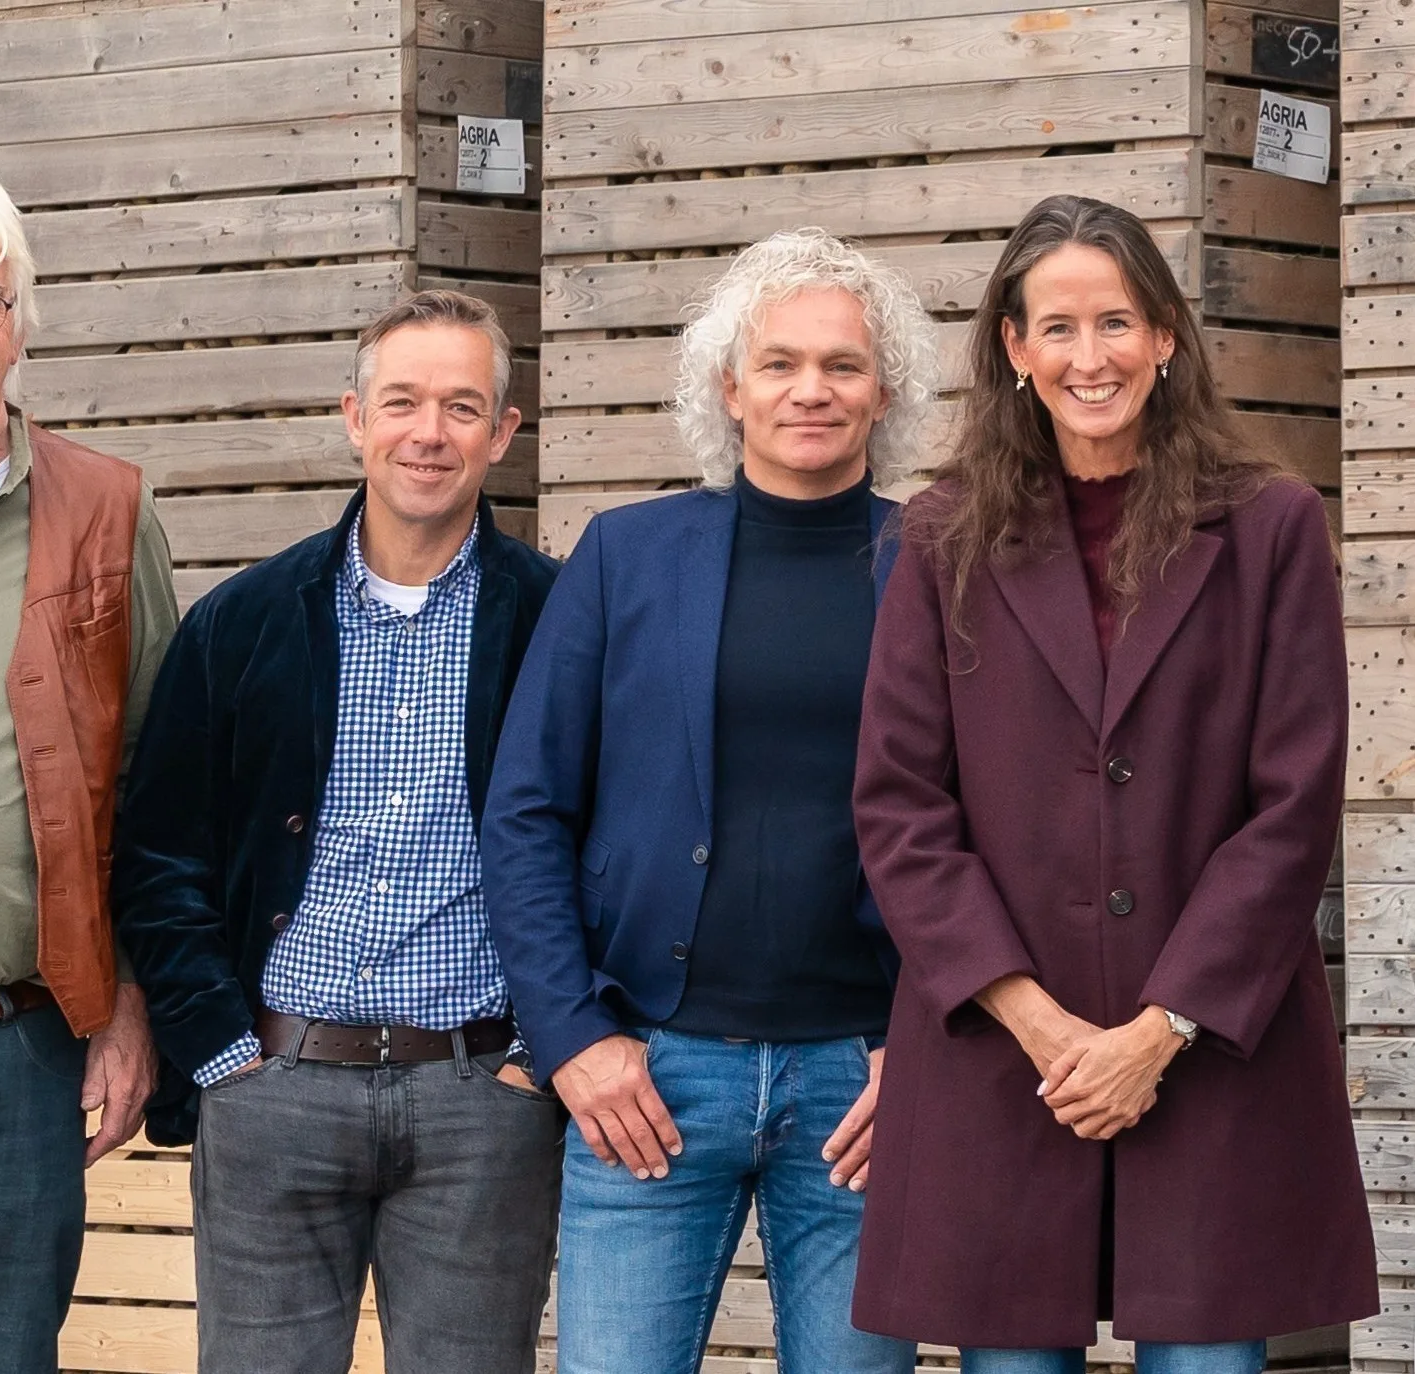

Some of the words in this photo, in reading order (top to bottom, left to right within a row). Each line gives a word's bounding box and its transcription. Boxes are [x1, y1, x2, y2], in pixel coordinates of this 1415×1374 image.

[1260, 100, 1307, 131] AGRIA
[459, 125, 500, 146] AGRIA
[1284, 128, 1293, 151] 2
[479, 148, 487, 168] 2
